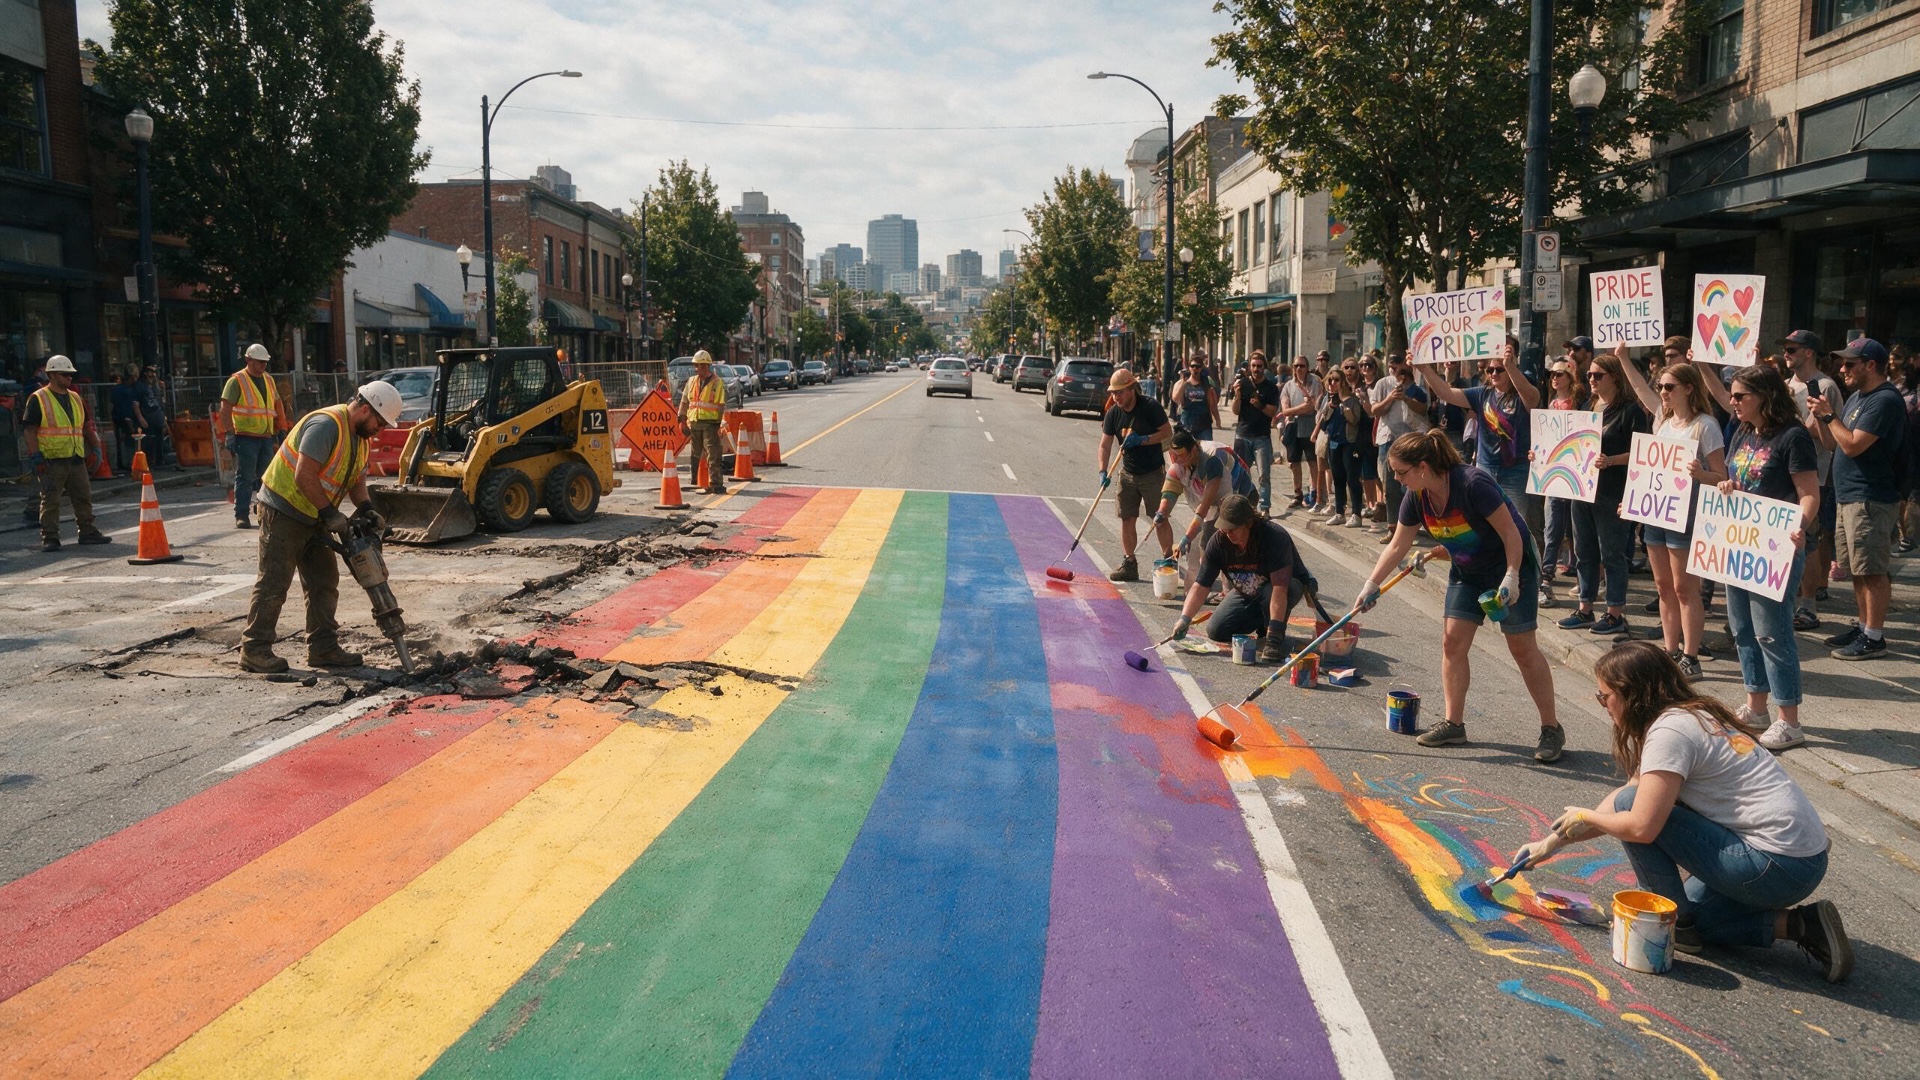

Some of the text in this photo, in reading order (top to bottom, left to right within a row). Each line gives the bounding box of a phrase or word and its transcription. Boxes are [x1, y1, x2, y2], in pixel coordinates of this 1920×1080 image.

[1595, 272, 1653, 302] PRIDE
[1413, 290, 1487, 320] PROTECT
[1603, 301, 1650, 319] ON THE
[1441, 316, 1473, 334] OUR
[1597, 320, 1660, 343] STREETS
[1431, 332, 1489, 361] PRIDE
[590, 412, 603, 429] 12
[642, 411, 671, 422] ROAD
[642, 425, 676, 436] WORK
[1636, 439, 1685, 472] LOVE
[1649, 471, 1663, 491] IS
[1627, 489, 1680, 523] LOVE
[1702, 491, 1796, 530] HANDS OFF
[1726, 524, 1760, 549] OUR
[1693, 541, 1789, 591] RAINBOW
